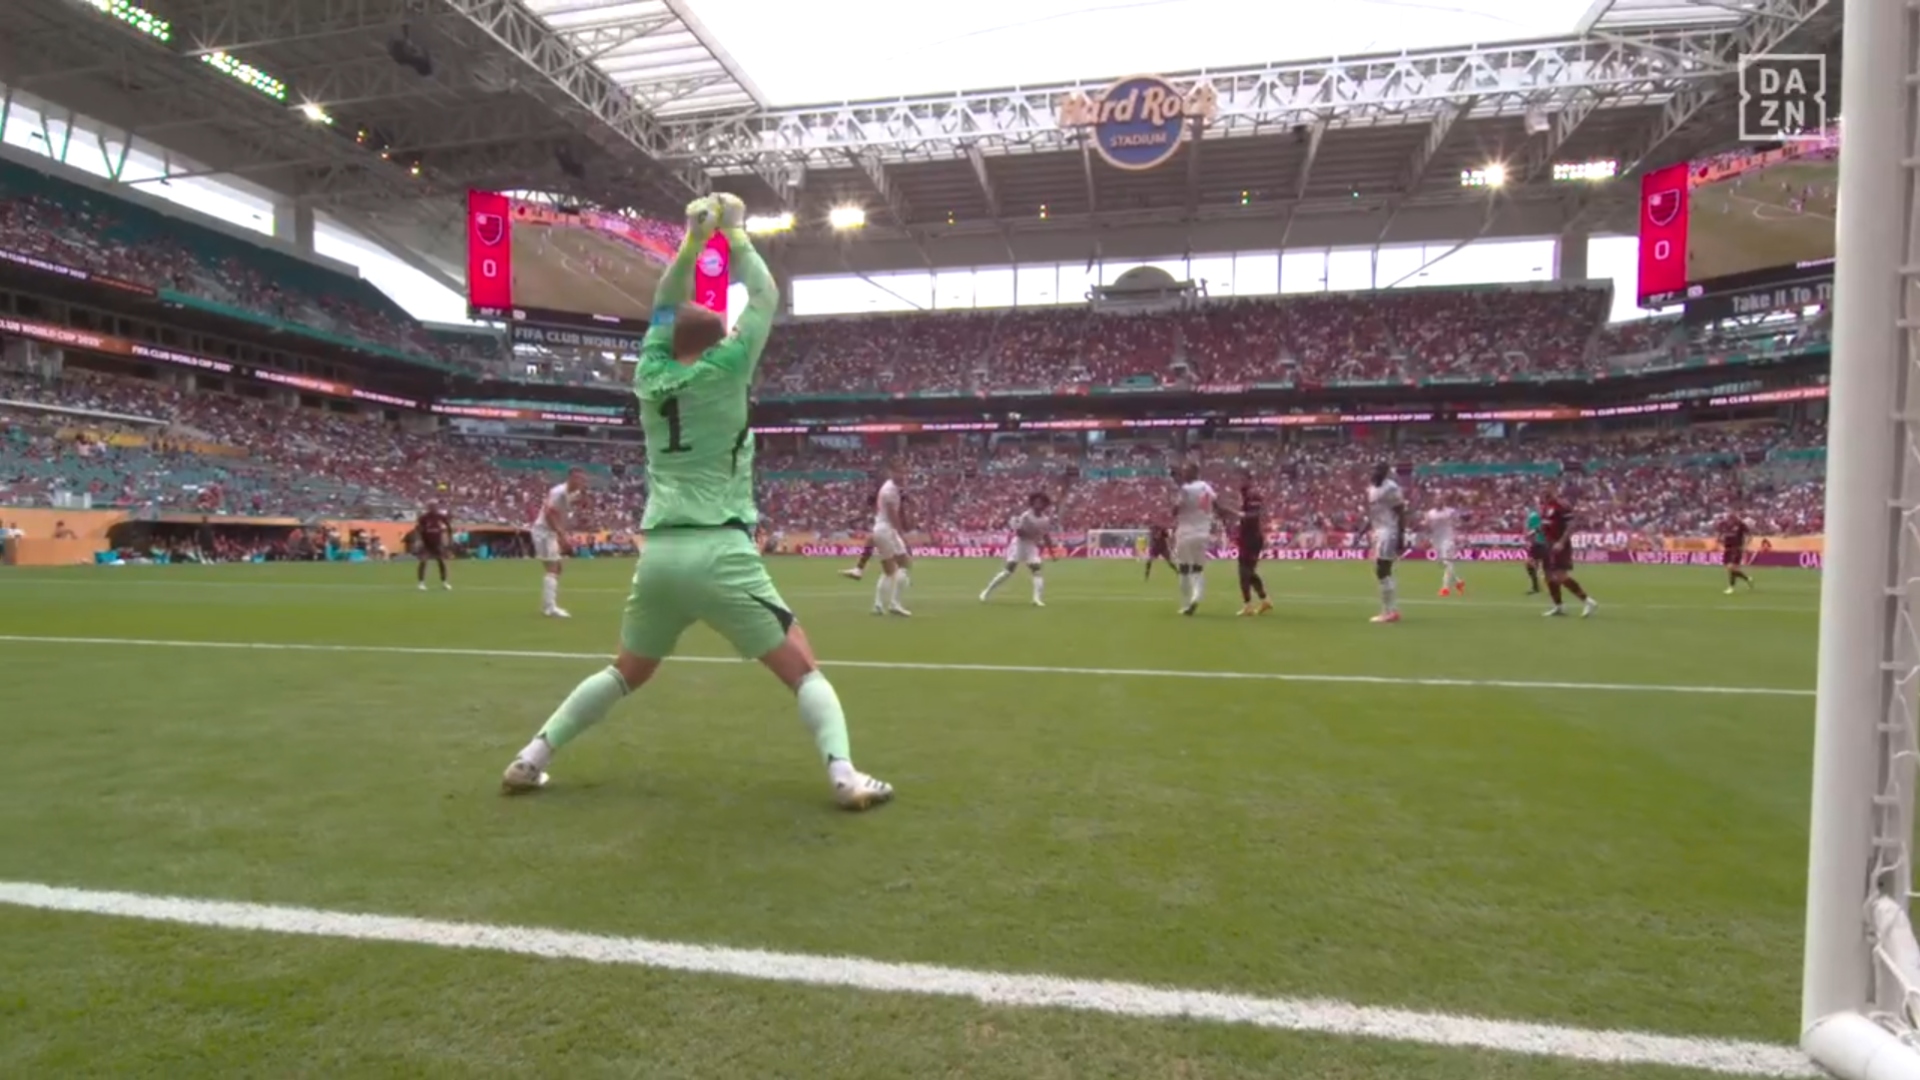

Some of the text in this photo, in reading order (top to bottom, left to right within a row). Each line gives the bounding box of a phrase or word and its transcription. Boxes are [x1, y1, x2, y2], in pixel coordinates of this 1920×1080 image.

[1110, 133, 1167, 147] STADIUM
[1655, 240, 1669, 260] 0
[483, 259, 497, 278] 0
[705, 289, 717, 308] 2
[1790, 286, 1811, 304] To
[0, 319, 20, 331] LUB
[515, 326, 544, 341] FIFA
[546, 331, 580, 345] CLUB
[582, 335, 628, 349] WORLD
[657, 395, 693, 454] 1
[802, 545, 838, 557] QATAR
[911, 547, 960, 557] WORLD'S
[963, 547, 991, 557] BEST
[1277, 549, 1310, 559] BEST
[1312, 549, 1365, 560] AIRLINE
[1669, 552, 1689, 564] BEST
[1690, 552, 1725, 565] AIRLINE
